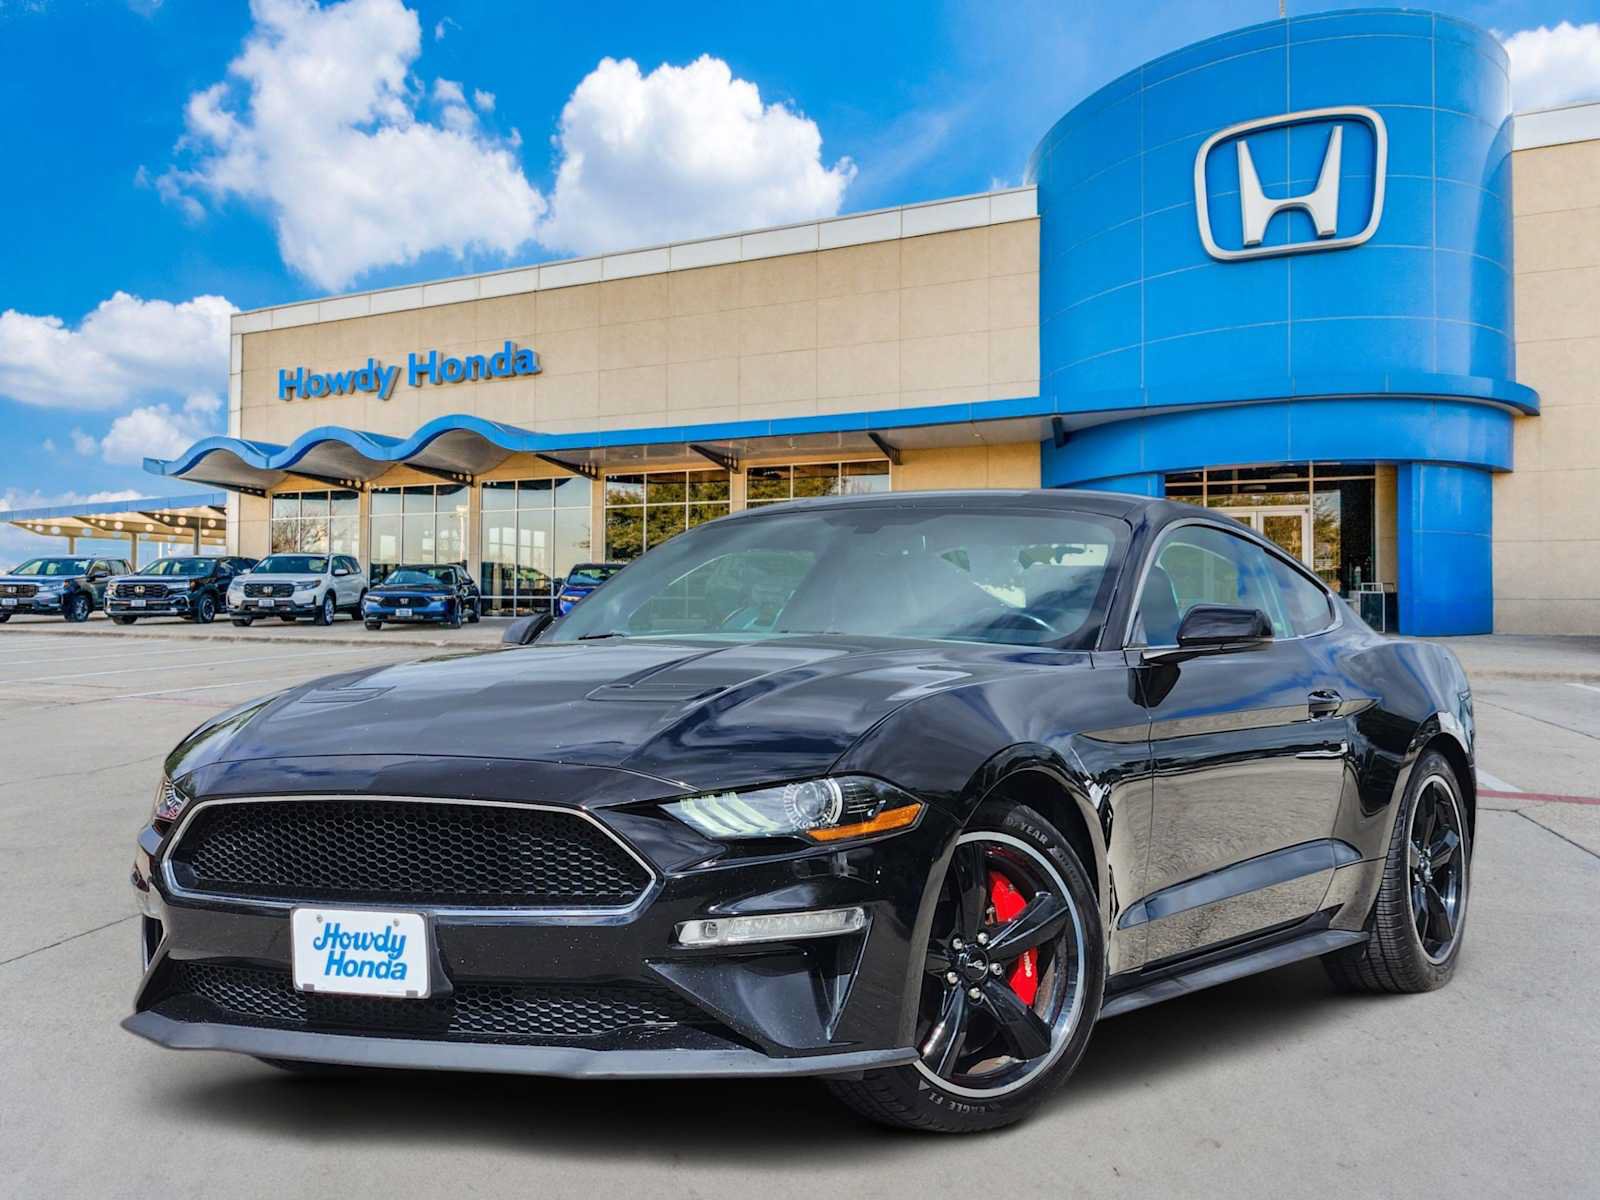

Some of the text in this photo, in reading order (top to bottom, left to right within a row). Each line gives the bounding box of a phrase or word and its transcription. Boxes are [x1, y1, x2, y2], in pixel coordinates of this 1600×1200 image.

[278, 341, 540, 400] Howdy Honda
[313, 922, 407, 960] Howdy
[323, 950, 408, 980] Honda
